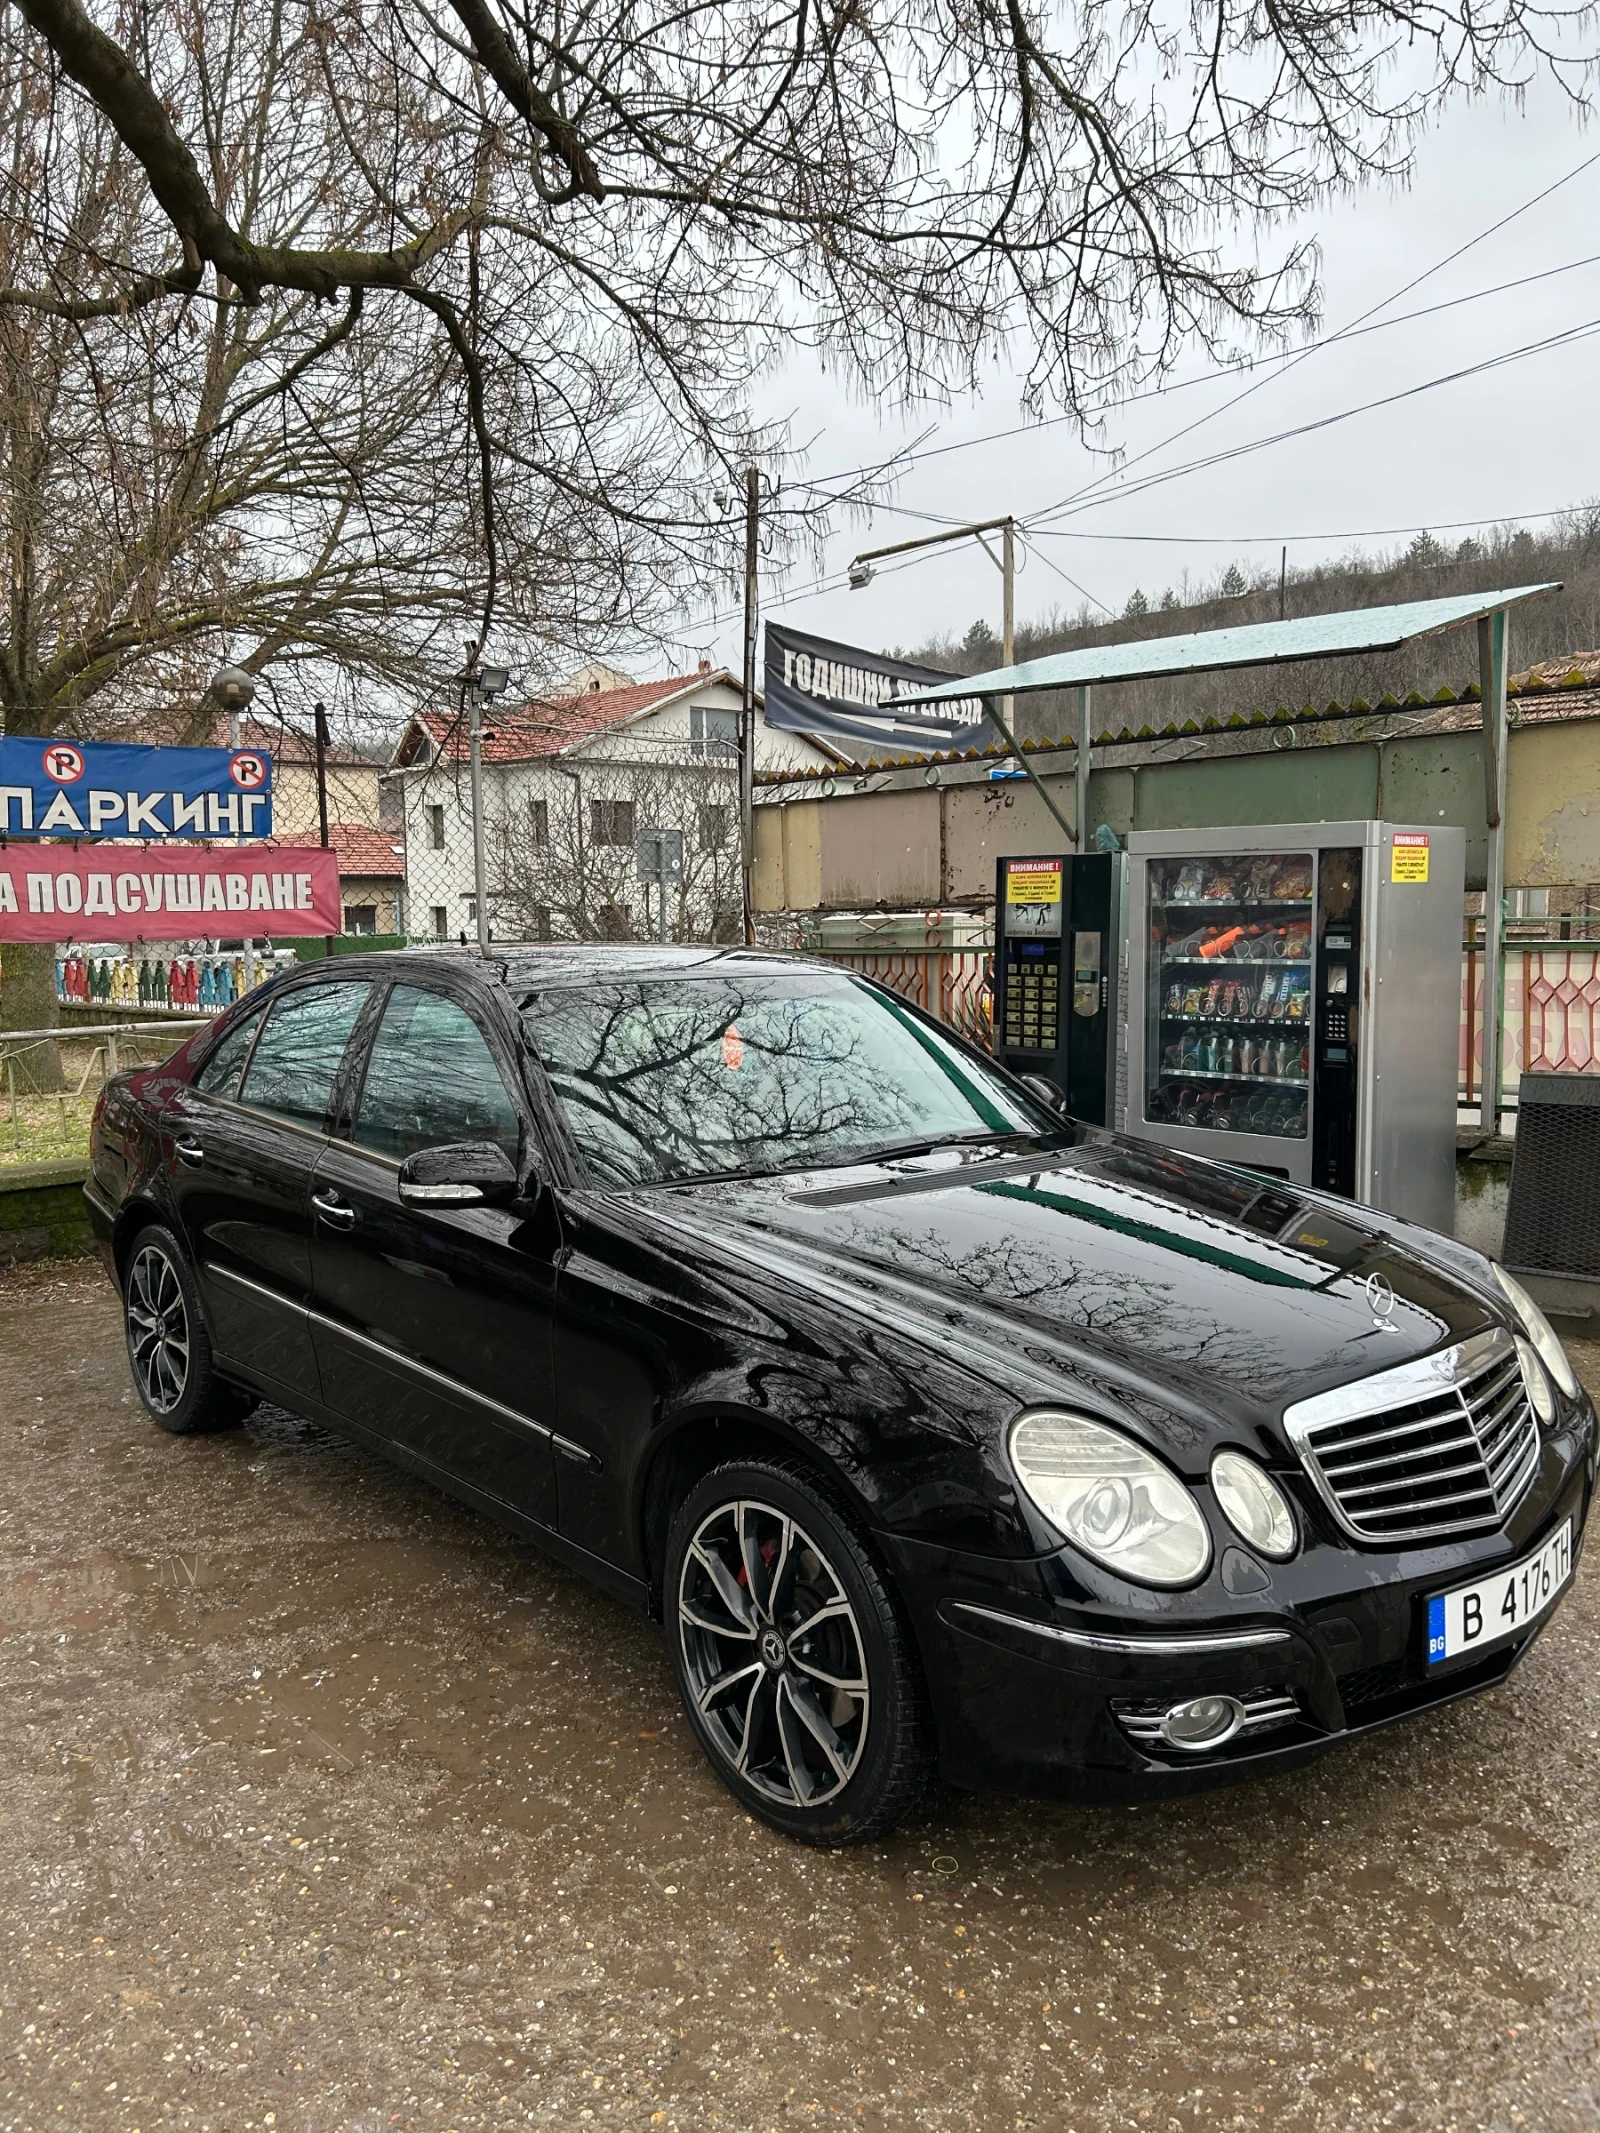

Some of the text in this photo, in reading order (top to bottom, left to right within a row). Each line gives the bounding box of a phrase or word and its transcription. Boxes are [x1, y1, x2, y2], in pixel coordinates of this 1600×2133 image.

[784, 649, 891, 709] ГОДИШНИ
[0, 786, 265, 833] ПАРКИНГ
[1010, 863, 1054, 872] ВНИМАНИЕ
[27, 872, 314, 917] ПОДСУШАВАНЕ
[1462, 1526, 1569, 1643] B 4176 TH
[1429, 1635, 1445, 1654] BG
